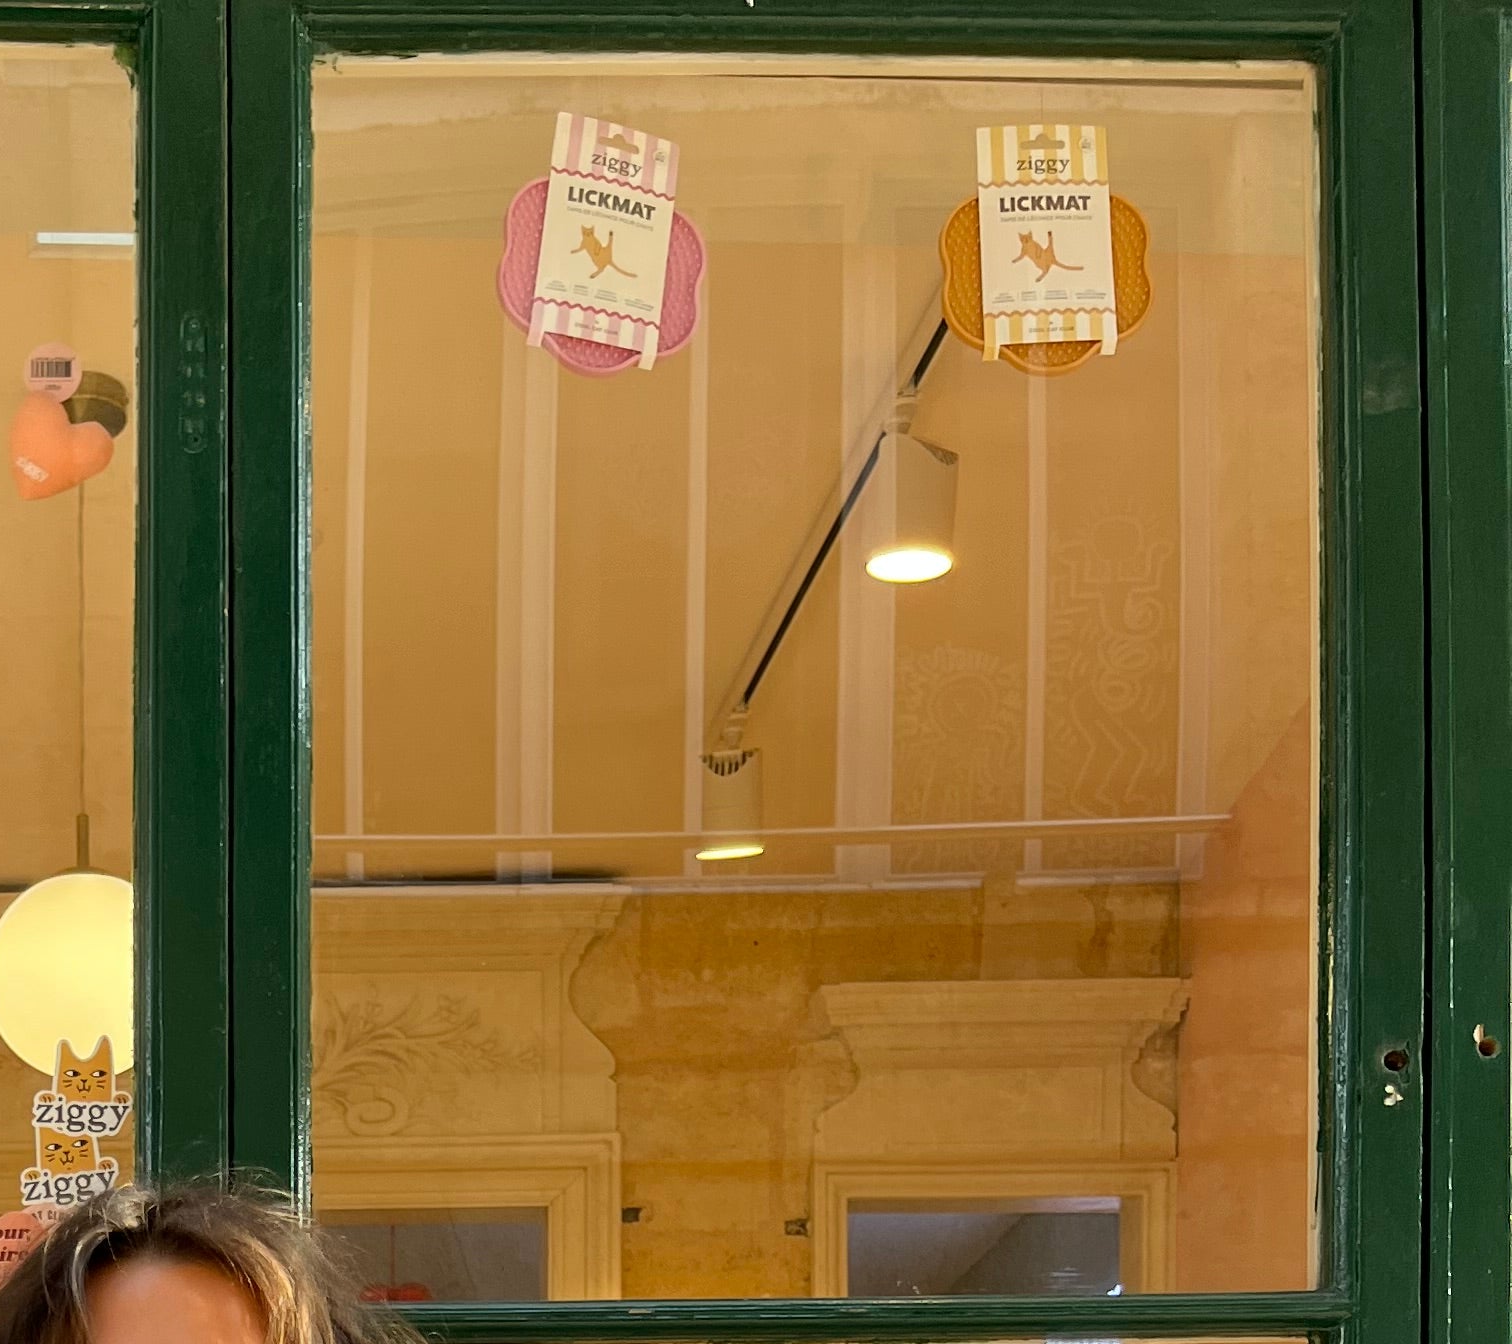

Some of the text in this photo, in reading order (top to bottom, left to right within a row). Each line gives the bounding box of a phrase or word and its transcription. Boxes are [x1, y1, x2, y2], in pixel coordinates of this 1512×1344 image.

[591, 152, 642, 177] ziggy
[1016, 156, 1070, 174] ziggy
[567, 185, 656, 221] LICKMAT
[999, 195, 1091, 213] LICKMAT
[36, 1096, 129, 1133] ziggy
[24, 1170, 116, 1206] ziggy
